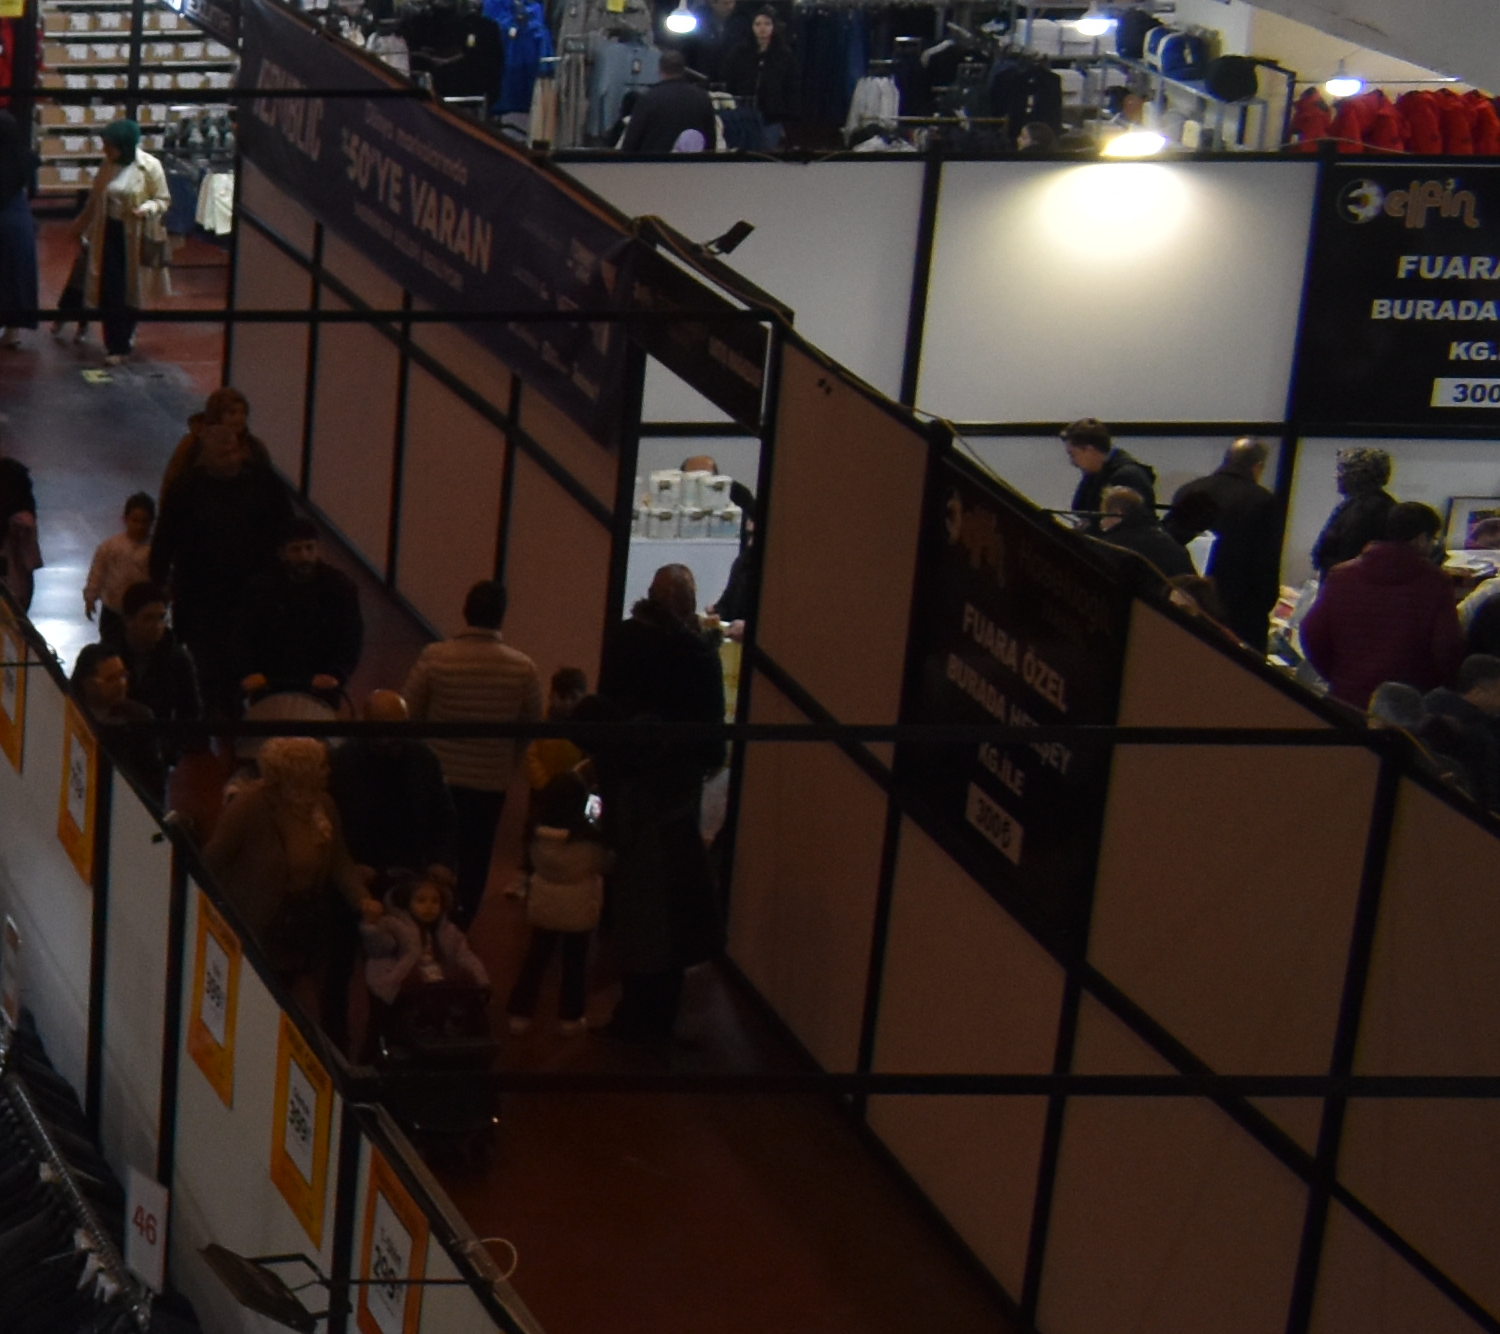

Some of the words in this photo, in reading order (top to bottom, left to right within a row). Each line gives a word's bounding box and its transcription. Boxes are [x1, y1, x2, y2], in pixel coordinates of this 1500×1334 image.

[409, 178, 492, 274] VARAN
[1370, 299, 1498, 321] BURADA
[133, 1204, 157, 1246] 46
